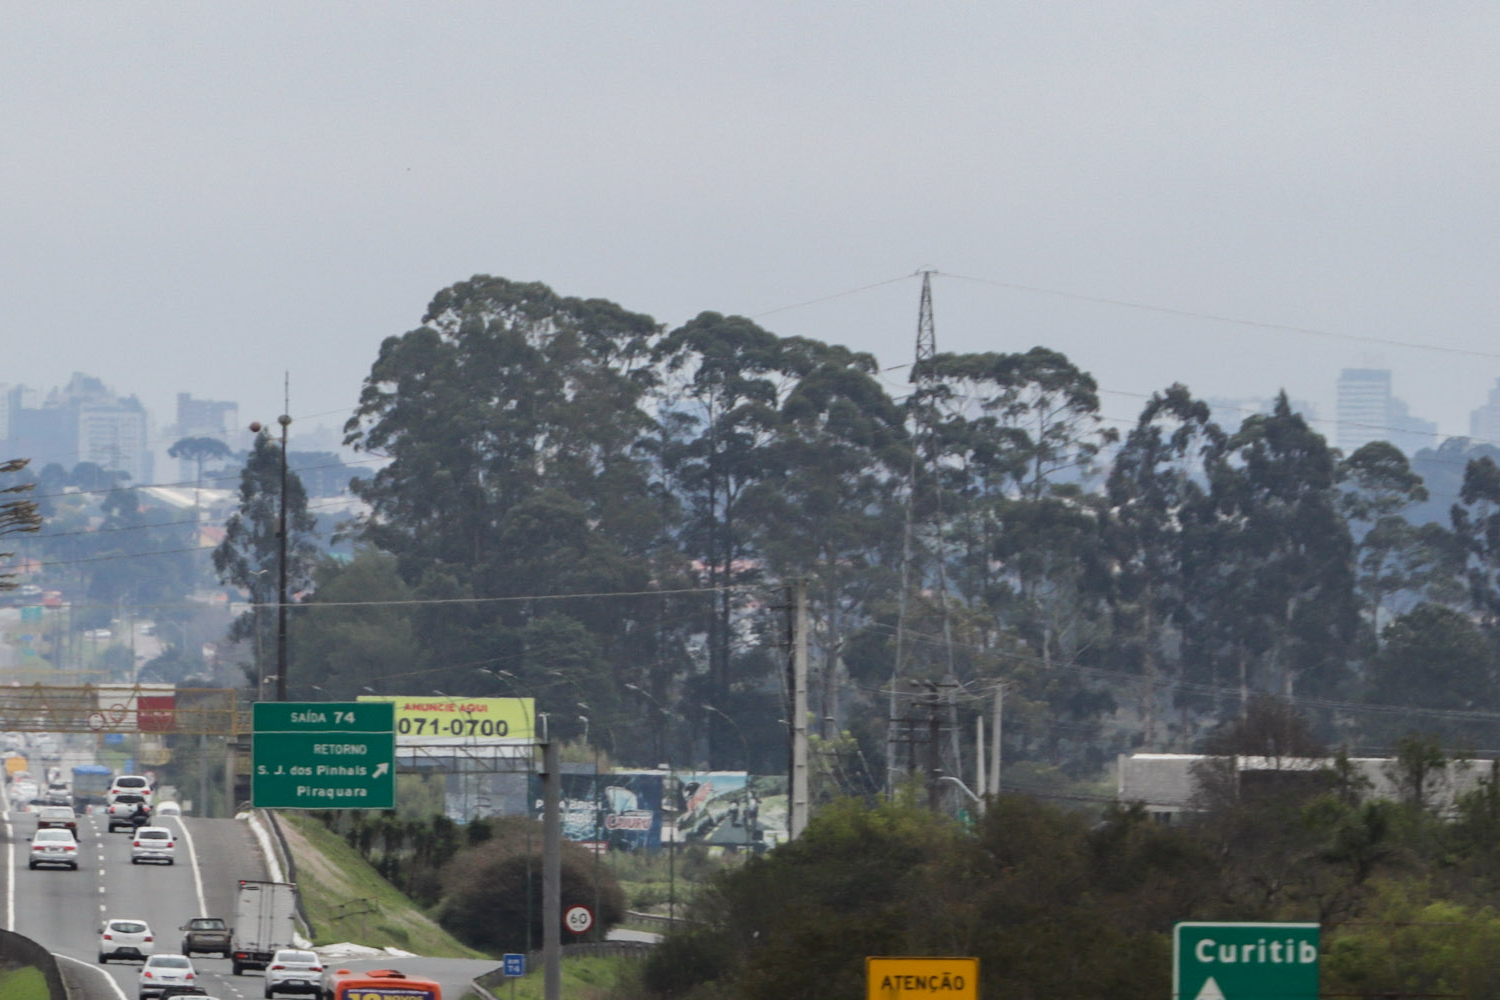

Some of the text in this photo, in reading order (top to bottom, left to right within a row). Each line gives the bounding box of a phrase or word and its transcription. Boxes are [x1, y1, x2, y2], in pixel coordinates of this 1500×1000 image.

[403, 703, 488, 713] ANUNCIE AQUI
[291, 711, 356, 723] SAÍDA 74
[398, 718, 509, 737] 071-0700
[314, 744, 368, 755] RETORNO
[258, 765, 368, 776] S. J. dos Pinhais
[297, 786, 368, 799] Piraquara
[570, 913, 587, 924] 60
[1195, 939, 1318, 963] Curitib
[881, 973, 965, 992] ATENÇÃO
